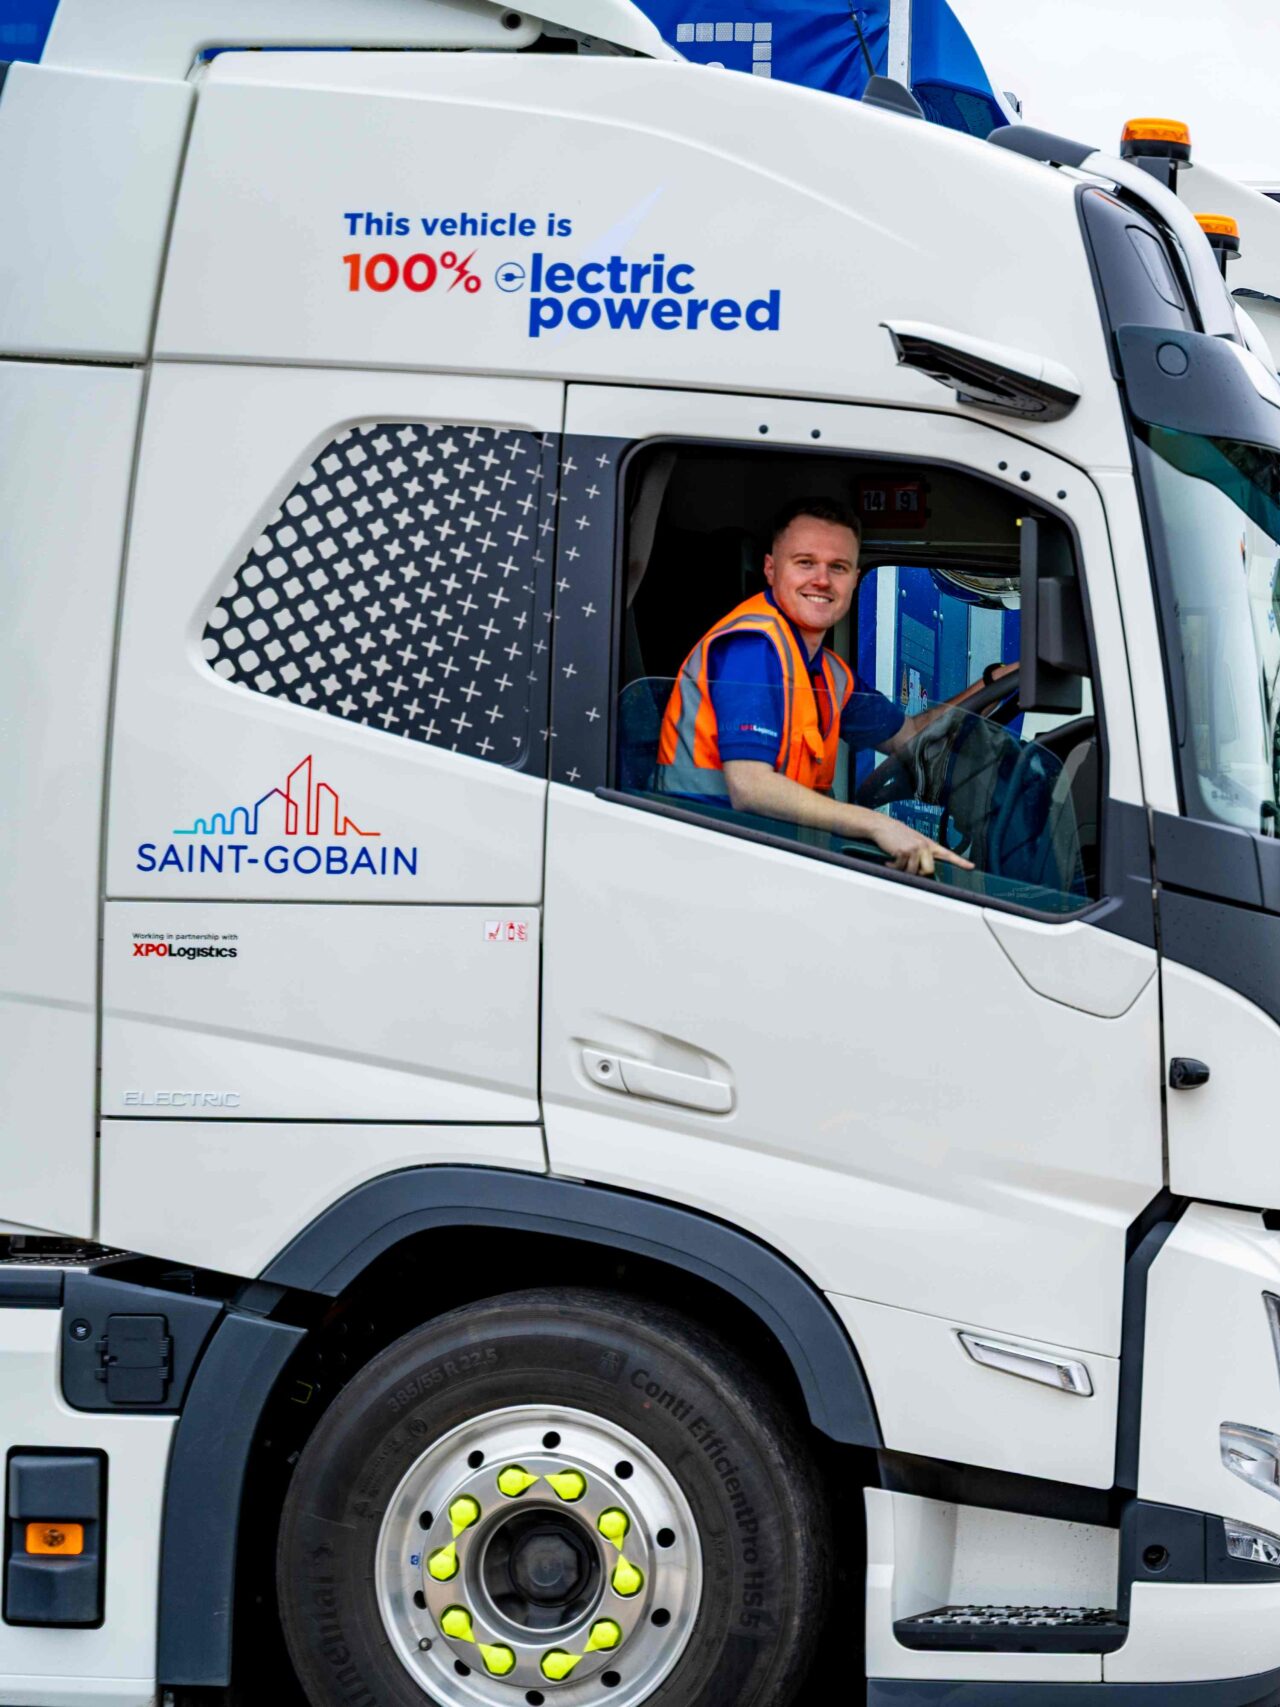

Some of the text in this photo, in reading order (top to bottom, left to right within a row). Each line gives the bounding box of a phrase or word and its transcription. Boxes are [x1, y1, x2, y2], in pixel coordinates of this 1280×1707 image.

[343, 212, 573, 237] This vehicle is
[342, 248, 482, 294] 100%
[528, 289, 781, 338] powered
[136, 843, 418, 876] SAINT-GOBAIN
[132, 932, 165, 941] Working
[166, 932, 174, 940] in
[175, 933, 219, 941] partnership
[123, 1090, 241, 1108] ELECTRIC
[630, 1368, 694, 1422] Conti
[687, 1415, 761, 1564] EfficientPro
